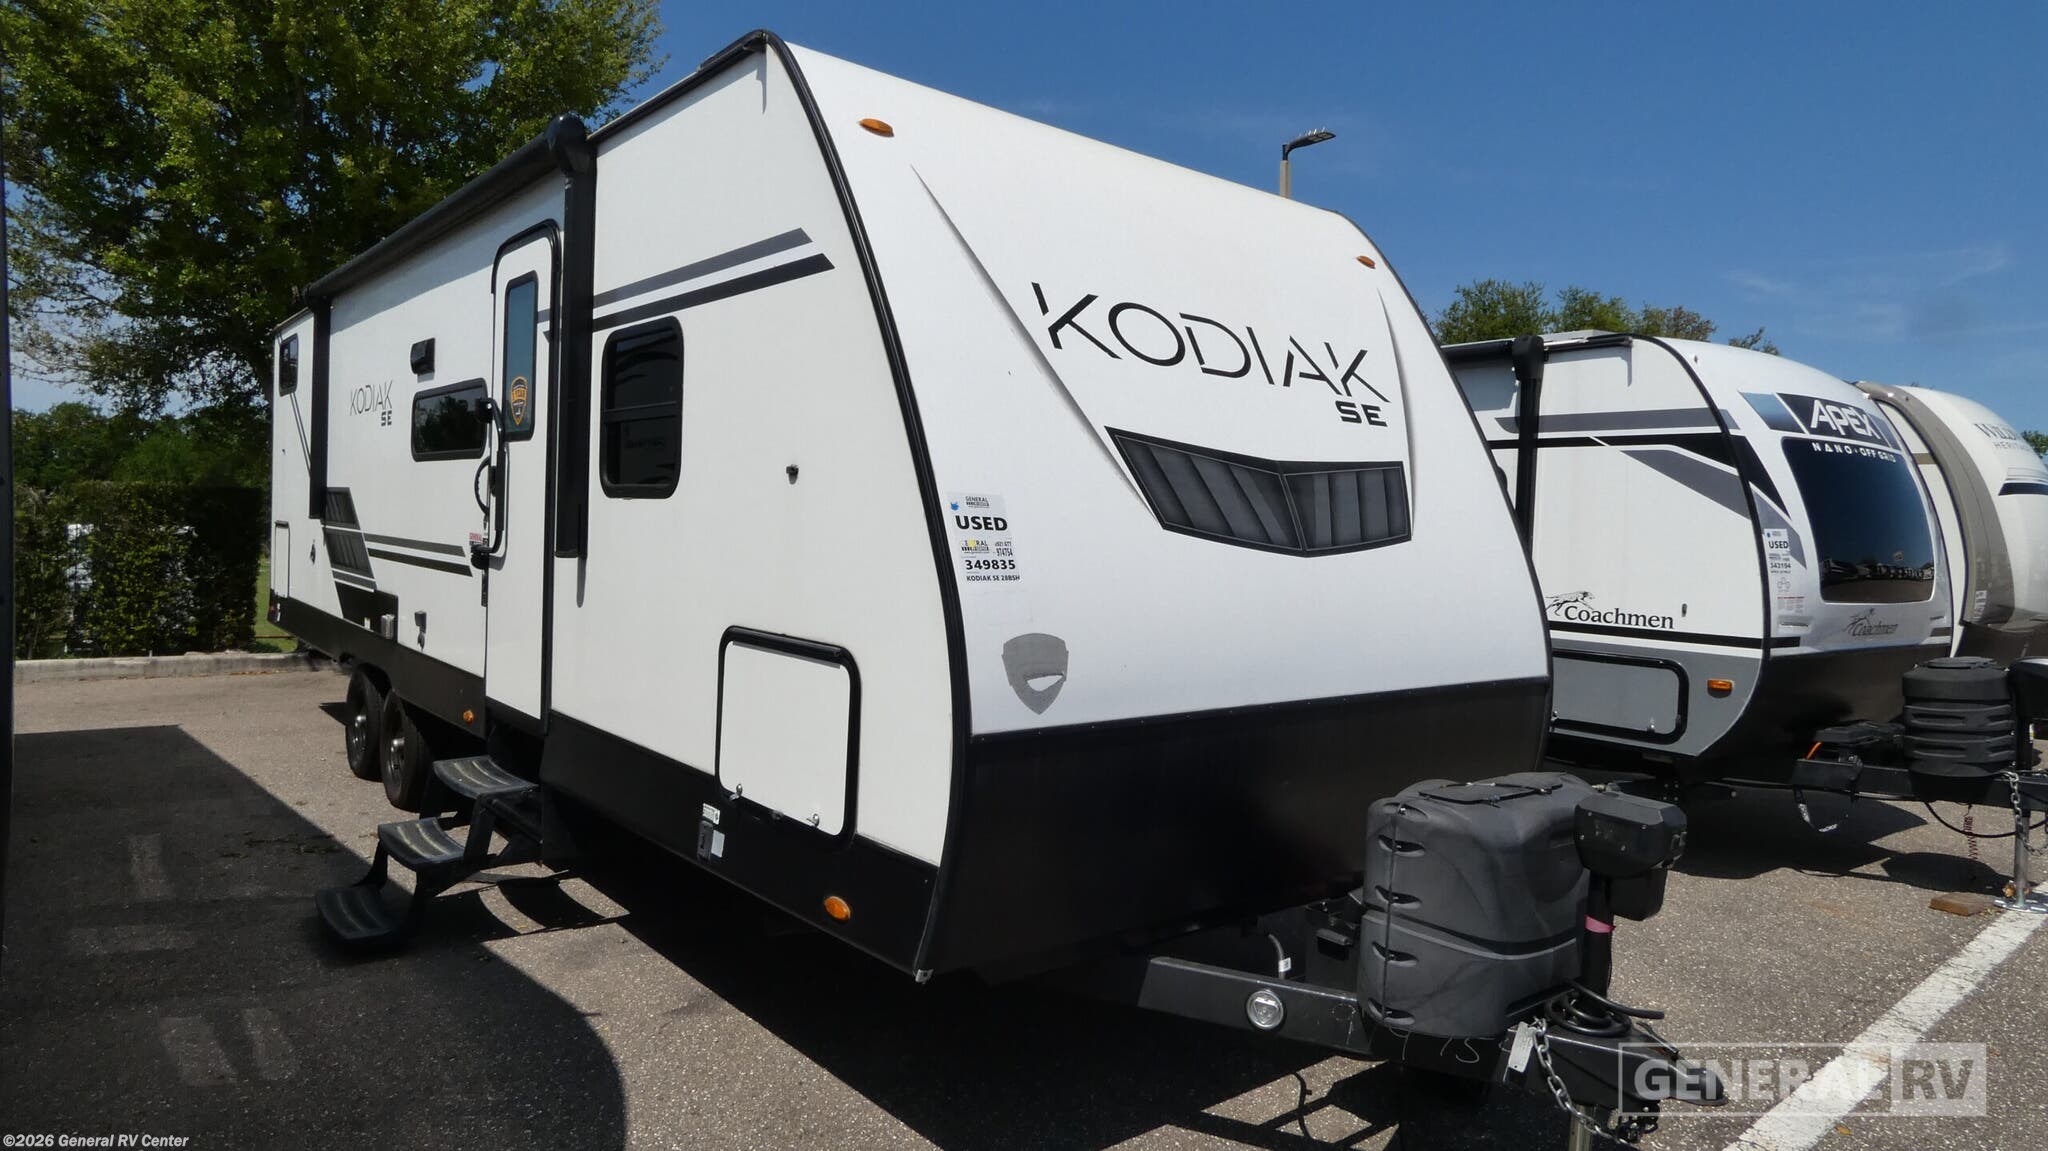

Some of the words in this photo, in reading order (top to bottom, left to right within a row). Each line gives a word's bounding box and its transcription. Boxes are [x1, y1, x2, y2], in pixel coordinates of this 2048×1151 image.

[1031, 281, 1391, 403] KODIAK
[349, 380, 393, 416] KODIAK
[381, 410, 392, 427] SE
[1335, 400, 1388, 427] SE
[1810, 399, 1881, 440] APEX
[1859, 447, 1877, 459] OFF
[955, 515, 1008, 531] USED
[1768, 541, 1789, 549] USED
[965, 559, 1016, 570] 349835
[1564, 605, 1676, 630] Coachmen
